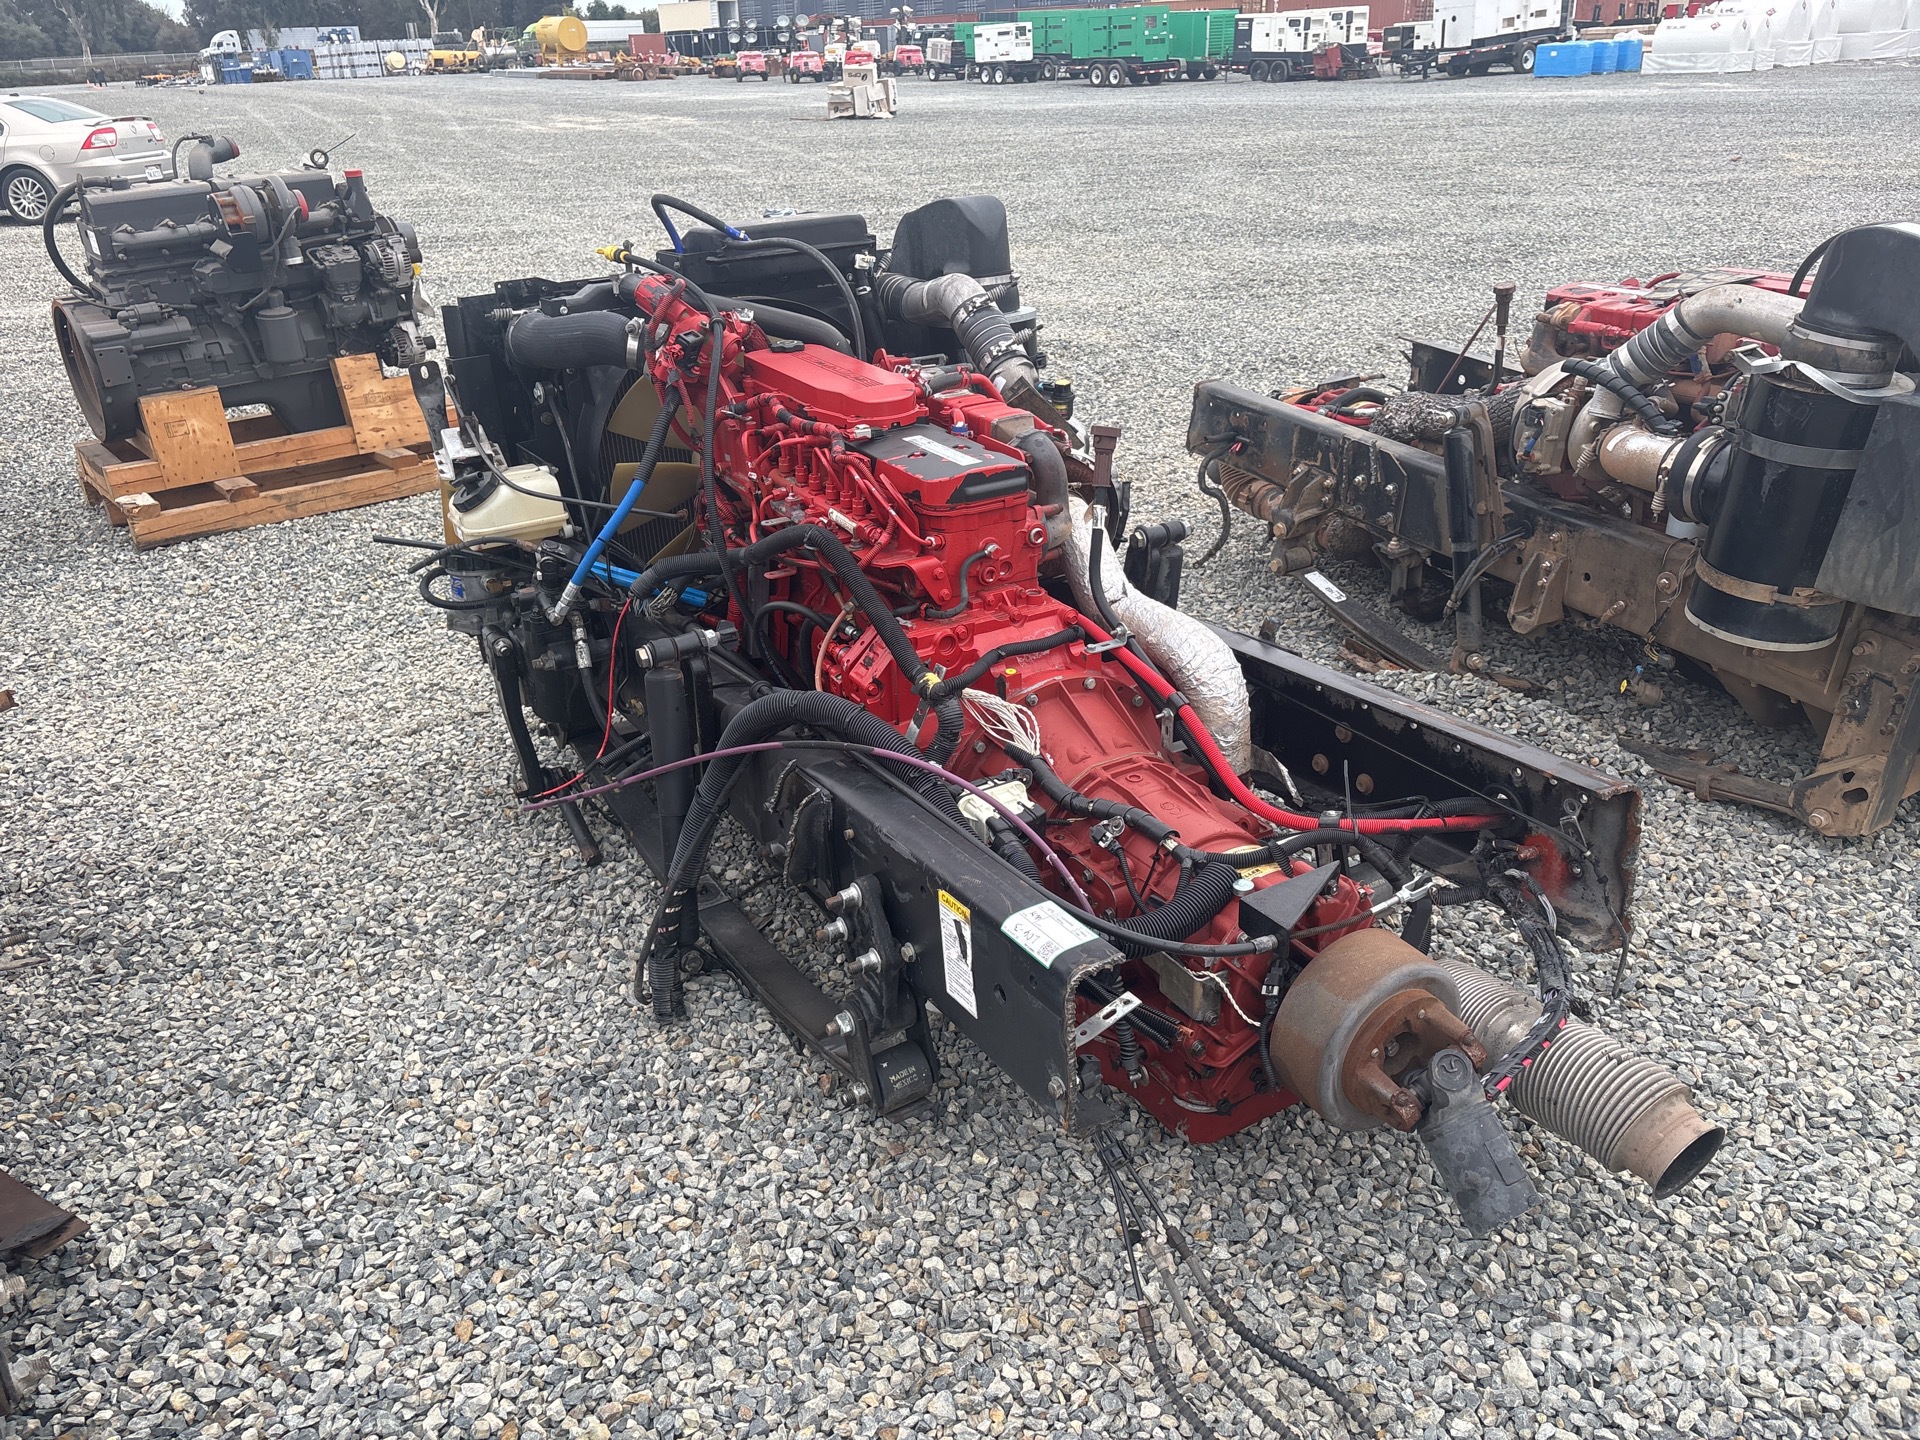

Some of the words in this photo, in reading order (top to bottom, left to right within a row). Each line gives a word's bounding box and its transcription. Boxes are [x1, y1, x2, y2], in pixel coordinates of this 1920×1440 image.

[941, 894, 967, 919] CAUTION
[889, 1069, 909, 1083] MADE
[908, 1065, 916, 1074] IN
[893, 1074, 919, 1091] MEXICO
